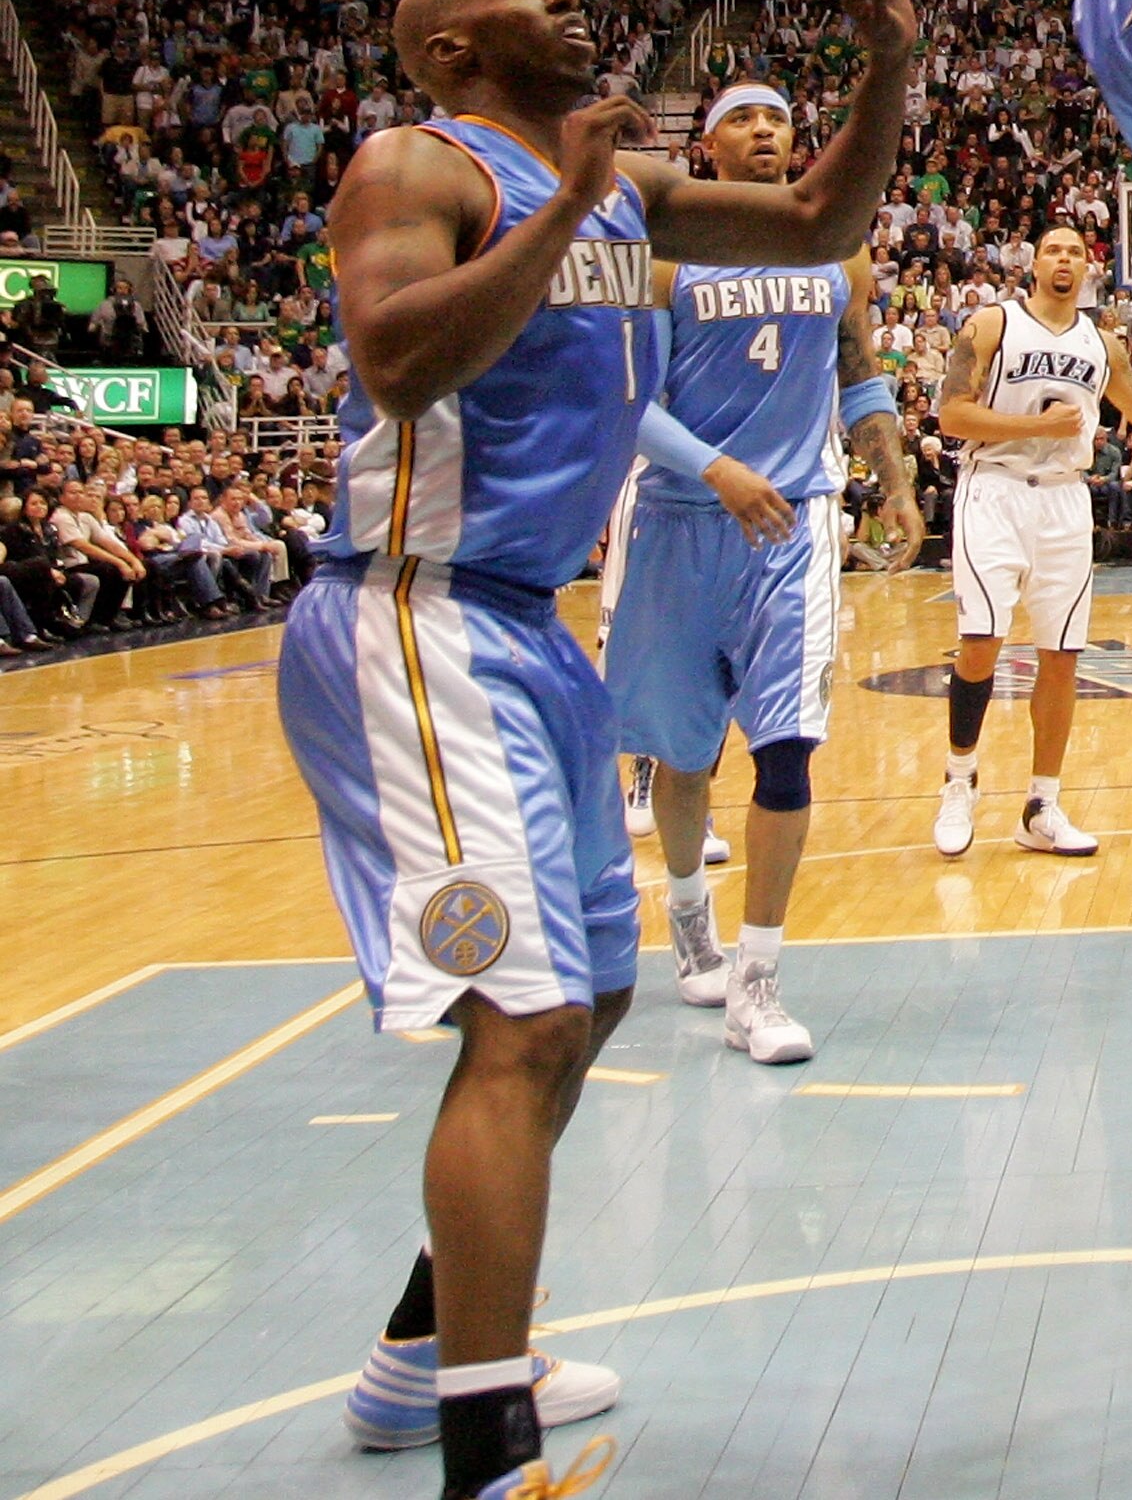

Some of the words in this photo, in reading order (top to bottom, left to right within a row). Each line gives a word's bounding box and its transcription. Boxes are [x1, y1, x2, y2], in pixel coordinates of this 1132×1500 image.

[550, 238, 652, 308] DENV
[692, 275, 832, 322] DENVER
[621, 317, 637, 403] 1
[748, 323, 781, 372] 4
[1007, 350, 1097, 393] JAZZ
